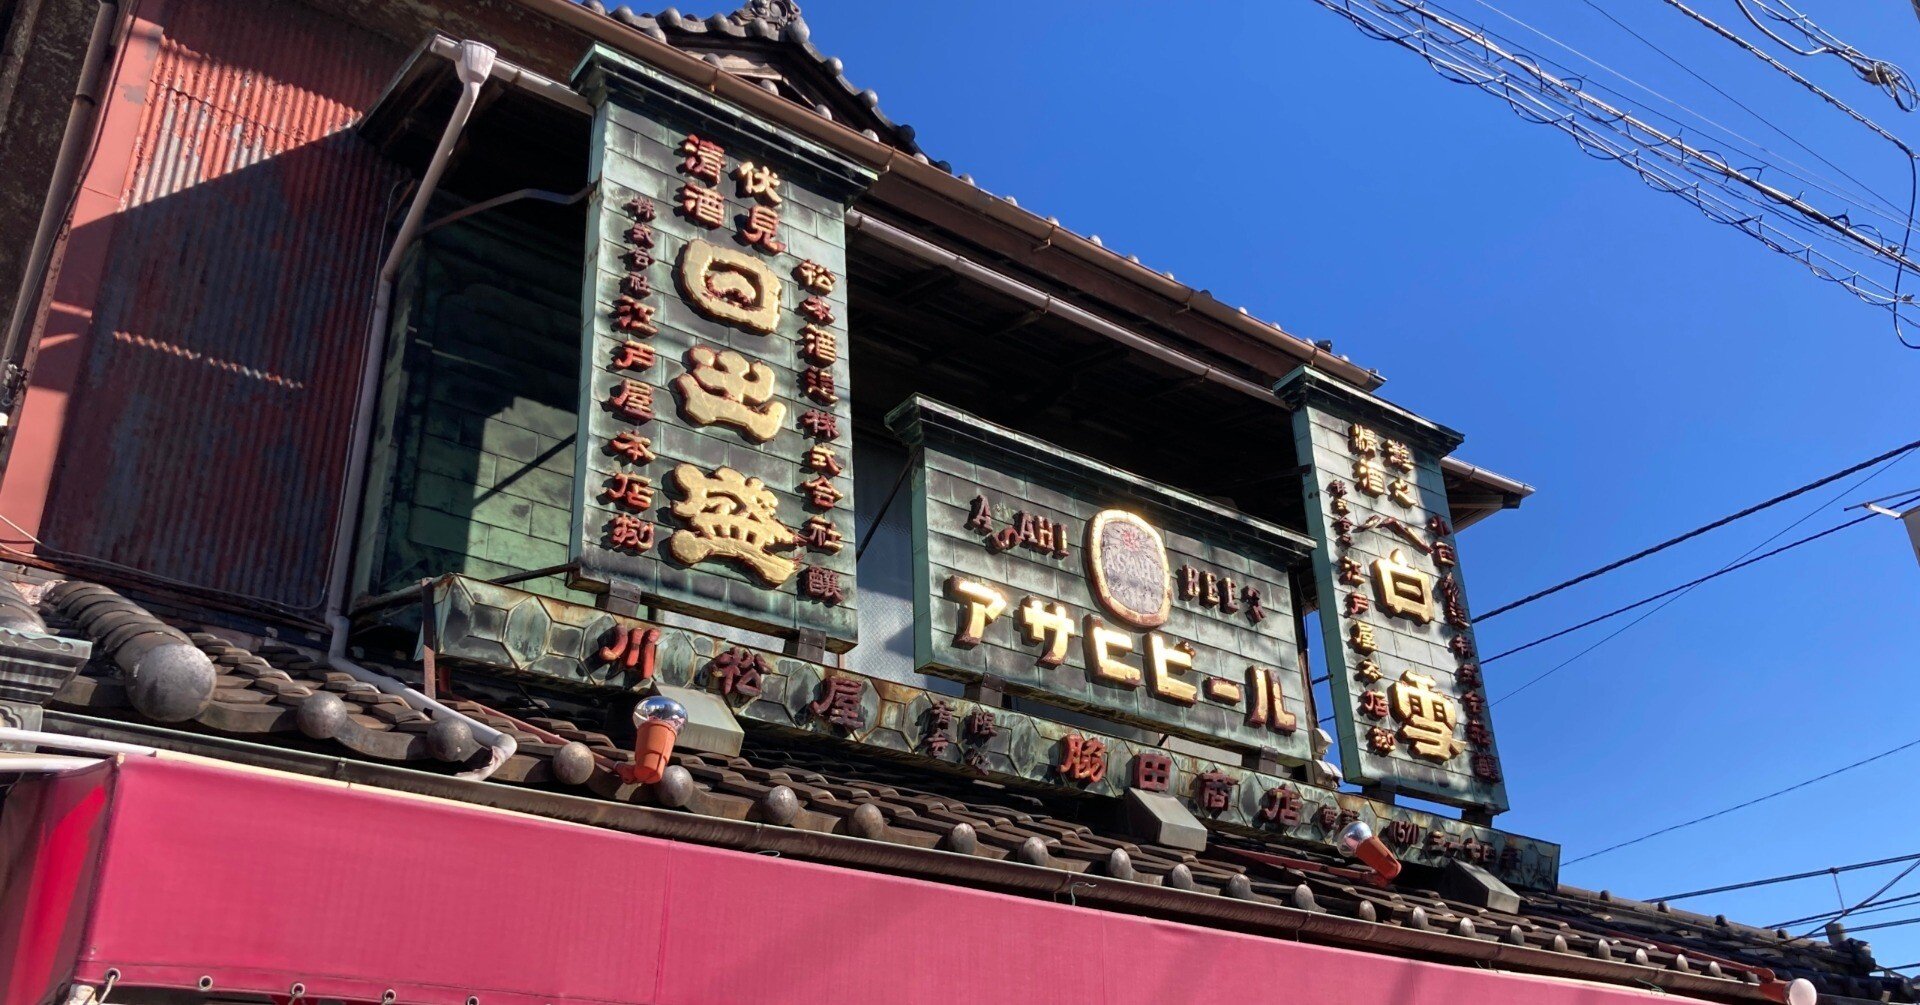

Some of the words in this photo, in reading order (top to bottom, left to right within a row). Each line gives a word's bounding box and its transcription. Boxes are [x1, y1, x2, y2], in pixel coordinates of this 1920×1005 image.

[679, 133, 727, 230] 清酒
[736, 160, 787, 256] 伏見
[669, 238, 805, 590] 日出盛
[967, 493, 1070, 561] ASAHI
[1175, 563, 1266, 624] BEER
[942, 574, 1297, 738] アサヒビール
[1369, 548, 1468, 766] 白雪
